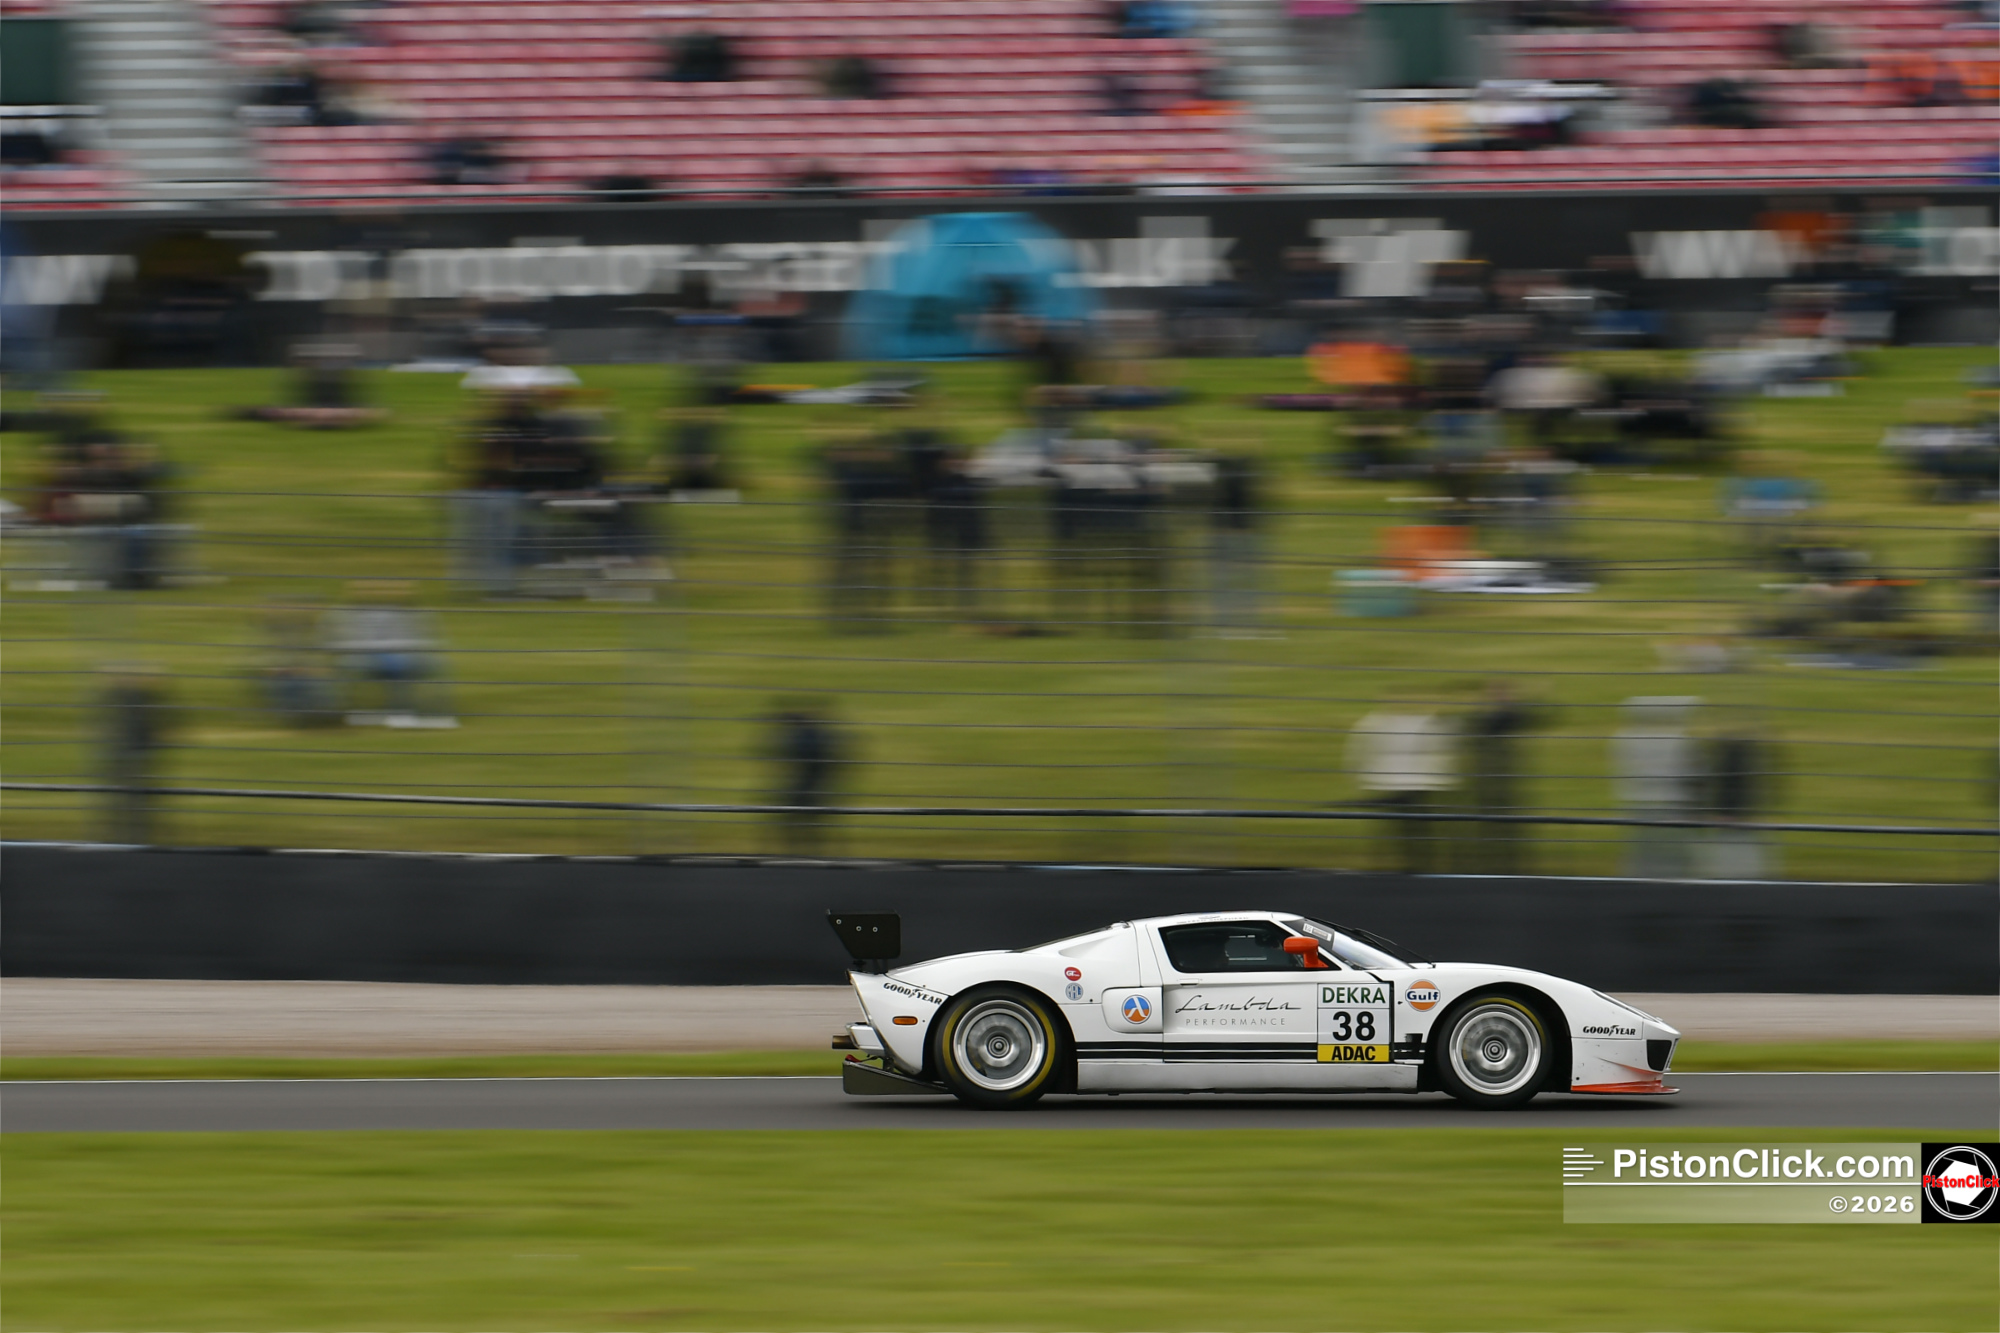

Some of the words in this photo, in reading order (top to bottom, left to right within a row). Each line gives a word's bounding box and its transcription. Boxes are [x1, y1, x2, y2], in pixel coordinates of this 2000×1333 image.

[883, 982, 943, 1005] GOODYEAR
[1322, 987, 1386, 1004] DEKRA
[1406, 990, 1439, 1001] Gulf
[1174, 994, 1302, 1014] Lambda
[1185, 1018, 1286, 1026] PERFORMANCE
[1332, 1010, 1376, 1042] 38
[1582, 1024, 1636, 1036] GOODYEAR
[1331, 1045, 1377, 1061] ADAC
